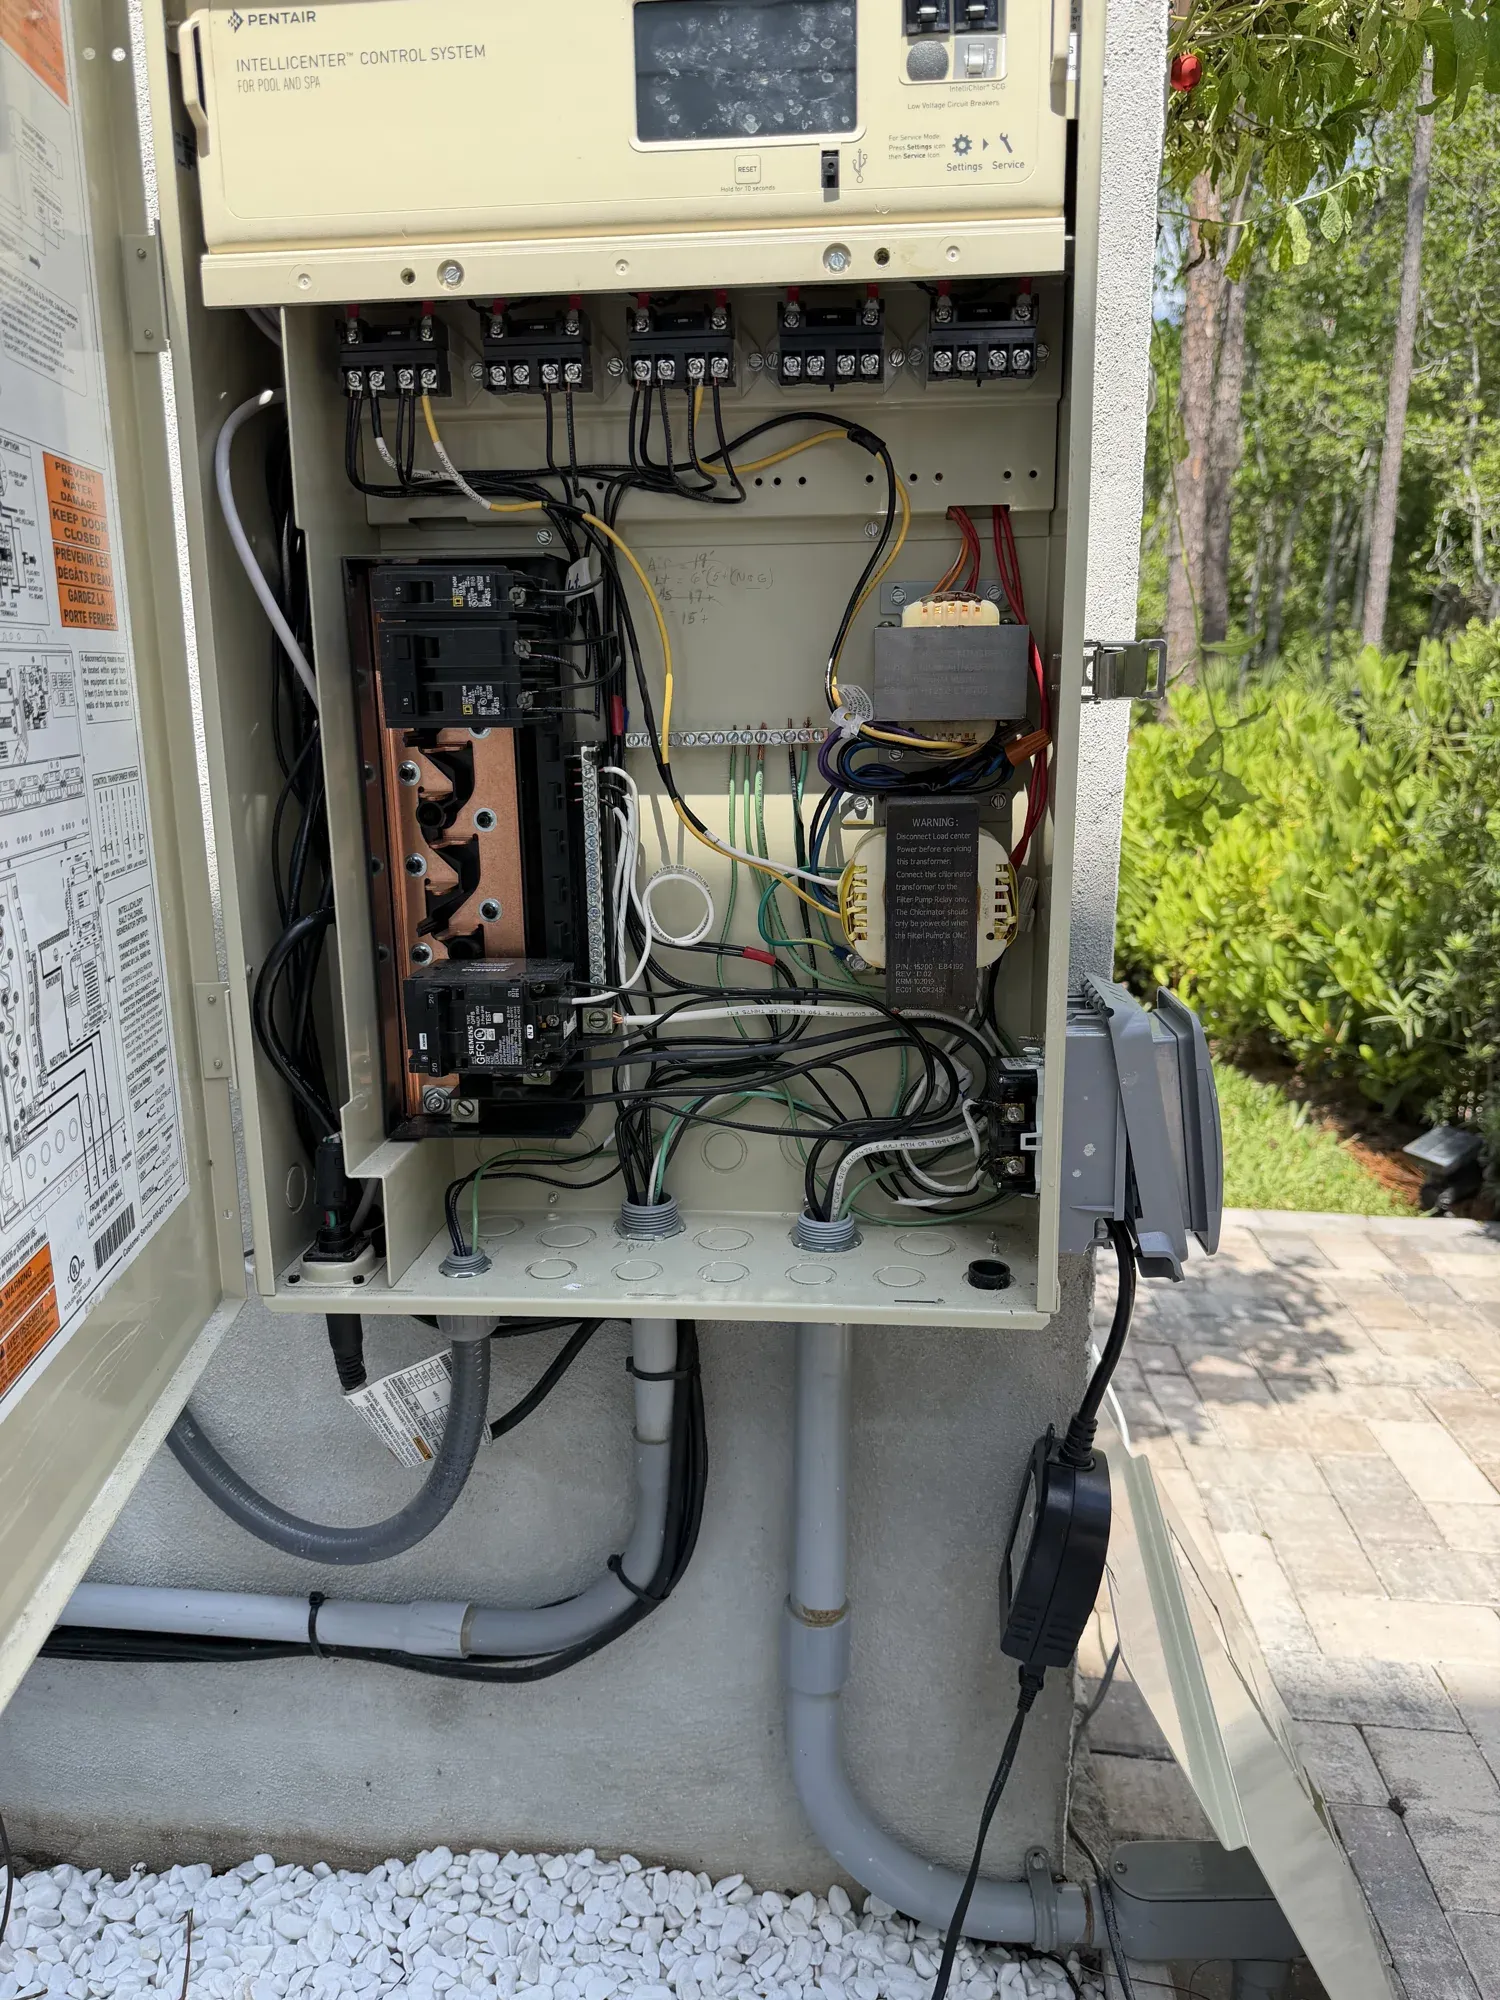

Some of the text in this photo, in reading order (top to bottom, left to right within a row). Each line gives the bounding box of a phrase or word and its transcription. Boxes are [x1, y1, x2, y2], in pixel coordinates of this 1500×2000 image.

[248, 10, 316, 26] PENTAIR
[360, 48, 426, 65] CONTROL
[430, 44, 486, 62] SYSTEM
[238, 75, 321, 93] FOR POOL AND SPA
[922, 102, 945, 110] Voltage
[946, 160, 1025, 172] Settings Service
[55, 461, 96, 484] PREVENT
[62, 477, 93, 496] WATER
[61, 491, 97, 510] DAMAGE
[52, 507, 107, 533] KEEP DOOR
[64, 528, 100, 546] CLOSED
[56, 546, 109, 568] PRÉVENIR LES
[58, 565, 88, 584] DÉGÂTS
[68, 589, 105, 606] GARDEZ LA
[64, 609, 87, 624] PORTE
[912, 818, 959, 827] WARNING:
[895, 920, 908, 929] only
[46, 974, 61, 988] GROUND
[428, 994, 434, 1004] 20
[50, 1049, 68, 1067] NEUTRAL
[476, 1041, 485, 1064] GFCI
[432, 1063, 438, 1072] 20
[51, 1081, 56, 1092] L2
[48, 1103, 53, 1114] L1
[84, 1184, 89, 1195] L1
[89, 1179, 120, 1214] FROM MAIN PANEL
[122, 1233, 140, 1257] Customer
[140, 1219, 153, 1237] Service
[4, 1266, 32, 1300] WARNING
[6, 1302, 44, 1351] AVERTISSEMENT
